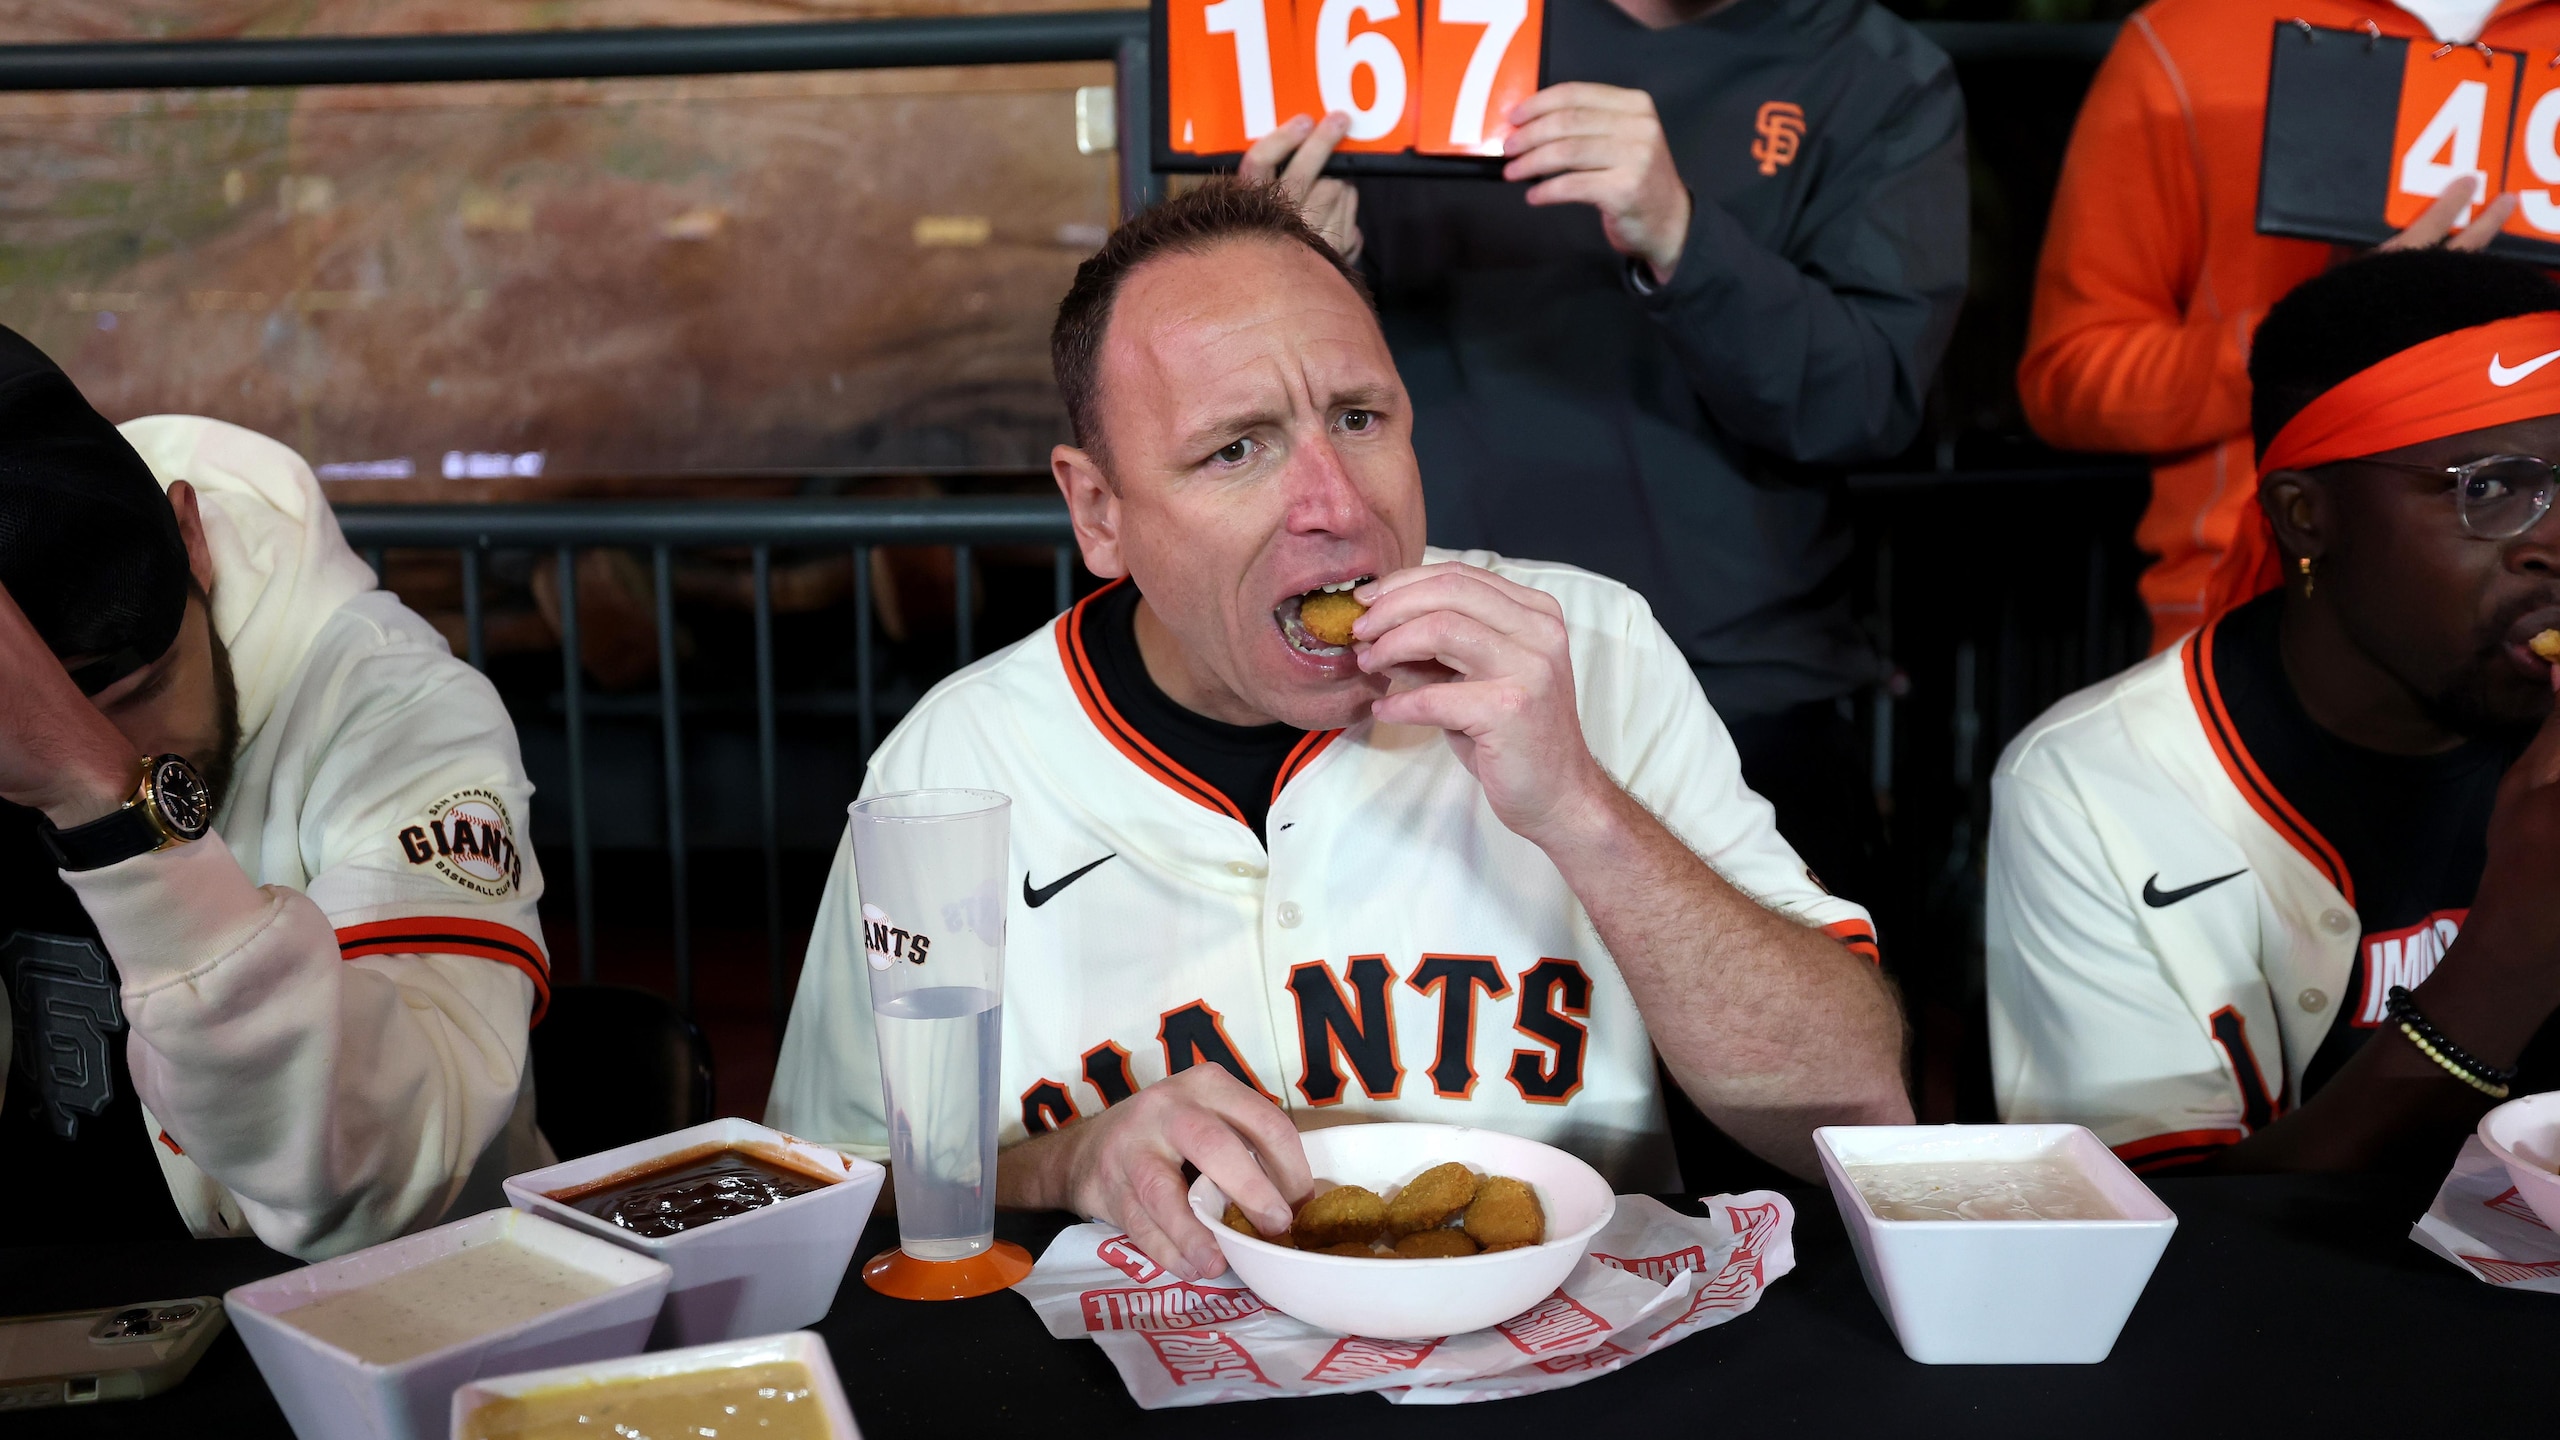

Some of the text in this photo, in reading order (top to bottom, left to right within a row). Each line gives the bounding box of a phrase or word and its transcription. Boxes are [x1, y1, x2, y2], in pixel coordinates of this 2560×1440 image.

[1204, 0, 1529, 141] 167
[428, 788, 514, 836] SAN FRANCISCO
[398, 819, 521, 892] GIANTS
[435, 860, 495, 896] BASEBALL
